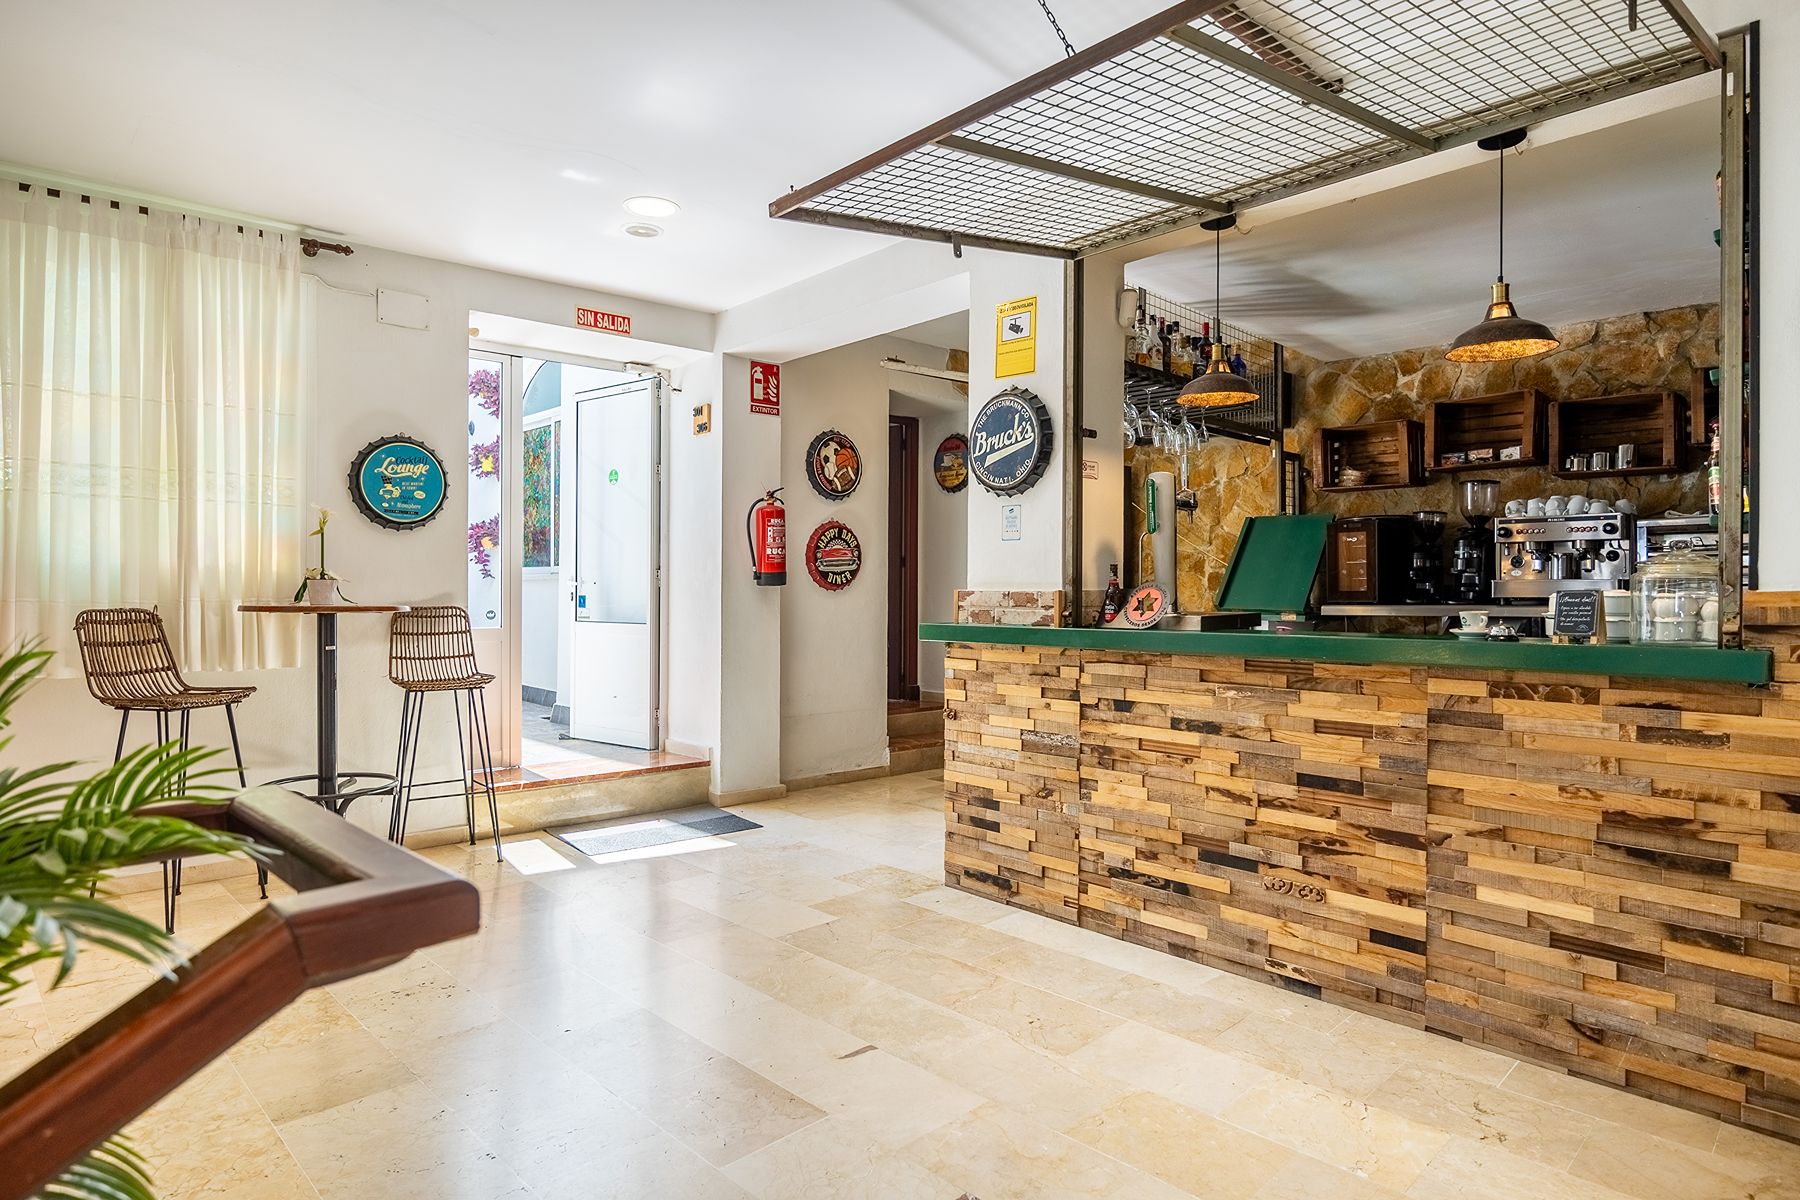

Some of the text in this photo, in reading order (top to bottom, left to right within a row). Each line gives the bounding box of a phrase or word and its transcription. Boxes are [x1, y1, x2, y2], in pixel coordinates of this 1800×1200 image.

[578, 309, 630, 333] SIN SALIDA
[692, 406, 703, 417] 301
[752, 405, 778, 415] EXTINTOR
[977, 415, 988, 428] THE
[986, 399, 1022, 416] BRUCKMANN
[973, 412, 1035, 458] Bruck's
[374, 456, 430, 478] Lounge
[396, 456, 428, 465] Cocktail
[817, 527, 858, 548] HAPPY DAYS
[827, 571, 852, 585] DINER
